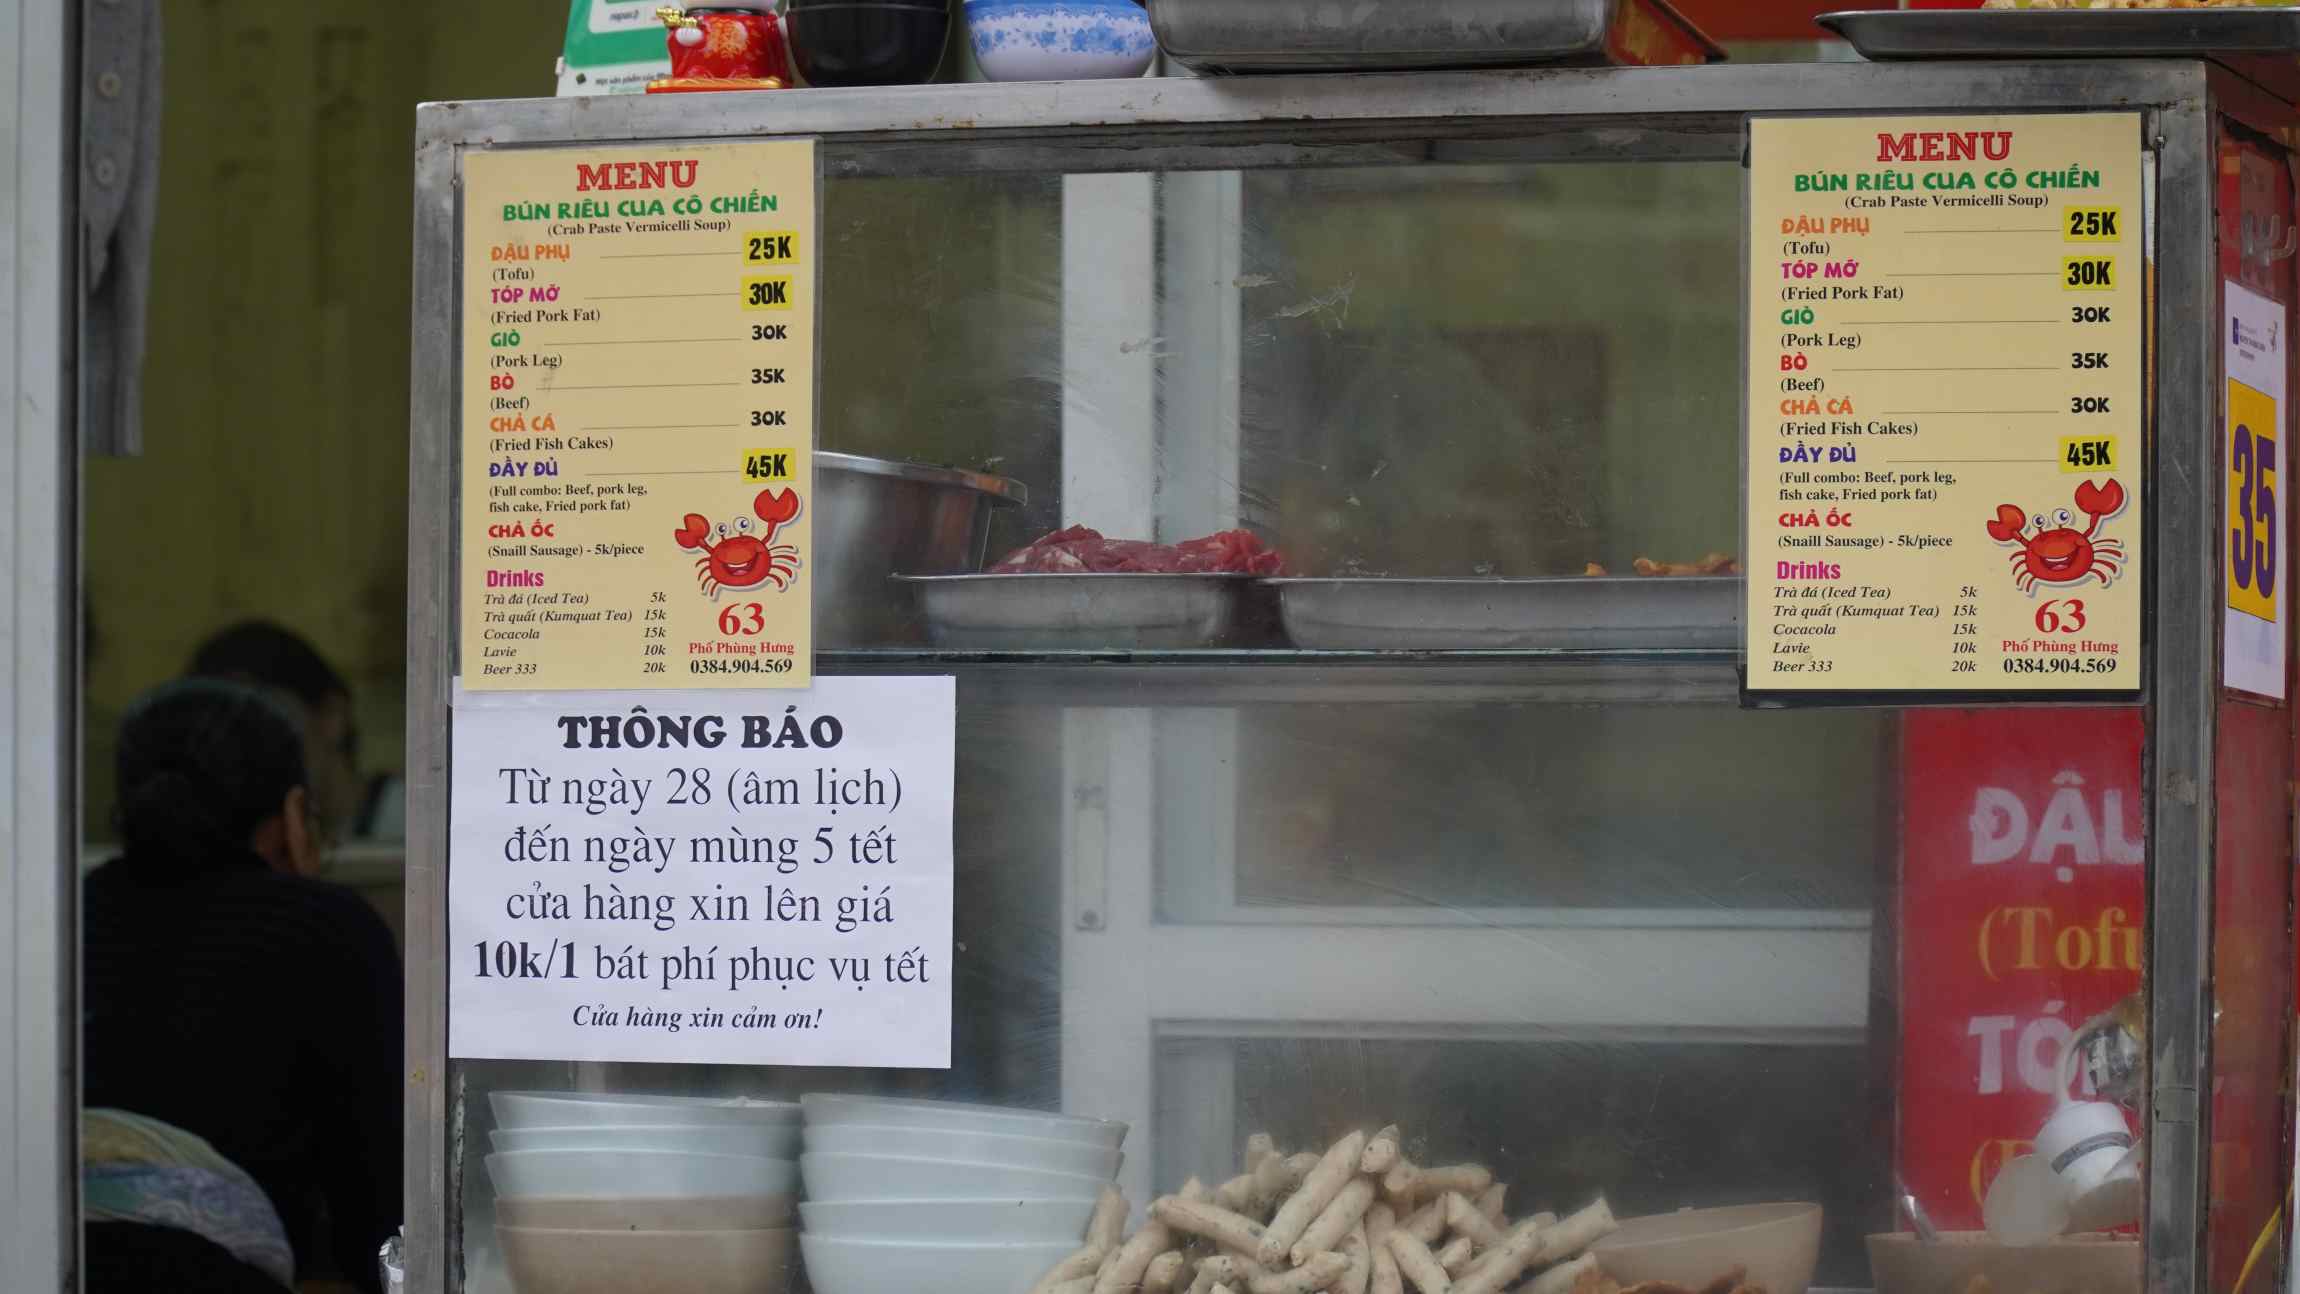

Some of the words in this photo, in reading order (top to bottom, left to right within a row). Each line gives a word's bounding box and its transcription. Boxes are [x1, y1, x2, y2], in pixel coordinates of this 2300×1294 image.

[1877, 131, 2013, 162] MENU
[577, 160, 698, 191] MENU
[1795, 171, 1847, 192] BÚN
[1856, 170, 1914, 191] RIÊU
[1923, 172, 1976, 190] CUA
[1985, 168, 2017, 189] CÔ
[2026, 163, 2099, 188] CHIẾN
[503, 201, 550, 221] BÚN
[558, 199, 609, 219] RIÊU
[617, 200, 665, 217] CUA
[673, 195, 702, 215] CÔ
[710, 189, 777, 213] CHIẾN
[1845, 196, 1886, 208] (Crab
[1891, 196, 1927, 207] Paste
[1932, 195, 2003, 206] Vermicelli
[2008, 195, 2048, 208] Soup)
[548, 224, 584, 235] (Crab
[589, 223, 621, 234] Paste
[626, 220, 690, 232] Vermicelli
[694, 220, 731, 232] Soup)
[1782, 215, 1824, 237] ĐẬU
[1830, 217, 1869, 236] PHỤ
[2071, 212, 2116, 235] 25K
[491, 243, 529, 264] ĐẬU
[535, 244, 570, 262] PHỤ
[749, 236, 791, 260] 25K
[1784, 242, 1830, 256] (Tofu)
[493, 268, 534, 281] (Tofu)
[1781, 260, 1818, 279] TÓP
[2068, 261, 2111, 285] 30K
[491, 285, 523, 304] TÓP
[749, 281, 786, 305] 30K
[1782, 287, 1827, 300] (Fried
[1832, 286, 1867, 299] Pork
[1874, 286, 1903, 299] Fat)
[491, 311, 531, 324] (Fried
[537, 310, 568, 322] Pork
[574, 309, 600, 321] Fat)
[1781, 306, 1814, 325] GIÒ
[2072, 307, 2110, 322] 30K
[491, 329, 520, 347] GIÒ
[752, 325, 787, 340] 30K
[1781, 333, 1823, 347] (Pork
[1828, 333, 1861, 349] Leg)
[491, 355, 528, 368] (Pork
[533, 354, 562, 369] Leg)
[1781, 352, 1807, 371] BÒ
[2072, 353, 2108, 368] 35K
[491, 372, 514, 390] BÒ
[752, 369, 785, 384] 35K
[1781, 378, 1824, 392] (Beef)
[491, 397, 529, 410] (Beef)
[1780, 395, 1820, 415] CHẢ
[1827, 396, 1853, 415] CÁ
[2072, 397, 2109, 413] 30K
[490, 412, 526, 432] CHẢ
[531, 413, 555, 432] CÁ
[751, 411, 786, 426] 30K
[1781, 422, 1825, 436] (Fried
[1832, 422, 1861, 434] Fish
[1868, 422, 1917, 435] Cakes)
[490, 438, 530, 453] (Fried
[536, 438, 563, 450] Fish
[568, 437, 613, 449] Cakes)
[1779, 441, 1823, 463] ĐẦY
[1829, 442, 1856, 462] ĐỦ
[2067, 441, 2110, 466] 45K
[489, 456, 528, 477] ĐẦY
[534, 457, 558, 476] ĐỦ
[747, 454, 787, 478] 45K
[1780, 472, 1809, 483] (Full
[1814, 472, 1859, 483] combo:
[1865, 472, 1896, 483] Beef,
[1901, 472, 1930, 485] pork
[1935, 472, 1956, 485] leg,
[1780, 489, 1802, 500] fish
[1806, 489, 1838, 501] cake,
[1843, 489, 1876, 499] Fried
[1881, 489, 1910, 502] pork
[1916, 488, 1937, 501] fat)
[1779, 509, 1820, 527] CHẢ
[1826, 507, 1851, 527] ỐC
[2233, 424, 2276, 598] 35
[489, 521, 525, 538] CHẢ
[531, 519, 554, 537] ỐC
[1779, 536, 1821, 547] (Snaill
[1825, 535, 1884, 549] Sausage)
[1898, 535, 1952, 549] 5k/piece
[487, 570, 544, 587] Drinks
[1777, 561, 1840, 579] Drinks
[1774, 587, 1797, 597] Trà
[1801, 587, 1818, 597] đá
[1822, 587, 1856, 600] (Iced
[1861, 587, 1891, 599] Tea)
[1960, 586, 1976, 597] 5k
[719, 603, 764, 635] 63
[1774, 605, 1797, 616] Trà
[1801, 605, 1832, 619] quất
[1836, 605, 1904, 619] (Kumquat
[1910, 605, 1939, 617] Tea)
[1954, 605, 1977, 616] 15k
[2035, 599, 2086, 633] 63
[1774, 624, 1836, 635] Cocacola
[1953, 624, 1976, 634] 15k
[690, 641, 713, 654] Phố
[717, 642, 756, 656] Phùng
[761, 642, 794, 655] Hưng
[1773, 643, 1810, 653] Lavie
[1953, 642, 1976, 653] 10k
[2003, 638, 2030, 652] Phố
[2033, 640, 2077, 655] Phùng
[2081, 640, 2118, 655] Hưng
[691, 659, 792, 673] 0384.904.569
[1773, 661, 1805, 672] Beer
[1808, 661, 1832, 672] 333
[1952, 661, 1975, 672] 20k
[2004, 659, 2116, 673] 0384.904.569
[558, 705, 727, 748] THÔNG
[741, 705, 842, 748] BÁO
[499, 768, 551, 804] Từ
[563, 768, 652, 815] ngày
[667, 768, 710, 804] 28
[728, 769, 800, 812] (âm
[816, 768, 901, 815] lịch)
[505, 824, 570, 862] đến
[584, 826, 675, 873] ngày
[690, 826, 798, 873] mùng
[814, 828, 833, 863] 5
[850, 825, 896, 863] tết
[507, 881, 571, 919] cửa
[584, 884, 675, 931] hàng
[690, 884, 749, 920] xin
[765, 885, 821, 921] lên
[836, 885, 894, 932] giá
[475, 938, 578, 978] 10k/1
[595, 945, 648, 979] bát
[661, 946, 717, 990] phí
[728, 946, 814, 990] phục
[829, 958, 870, 991] vụ
[885, 947, 928, 982] tết
[573, 1004, 618, 1026] Cửa
[626, 1006, 682, 1032] hàng
[689, 1008, 723, 1027] xin
[732, 1006, 776, 1028] cảm
[785, 1009, 822, 1028] ơn!
